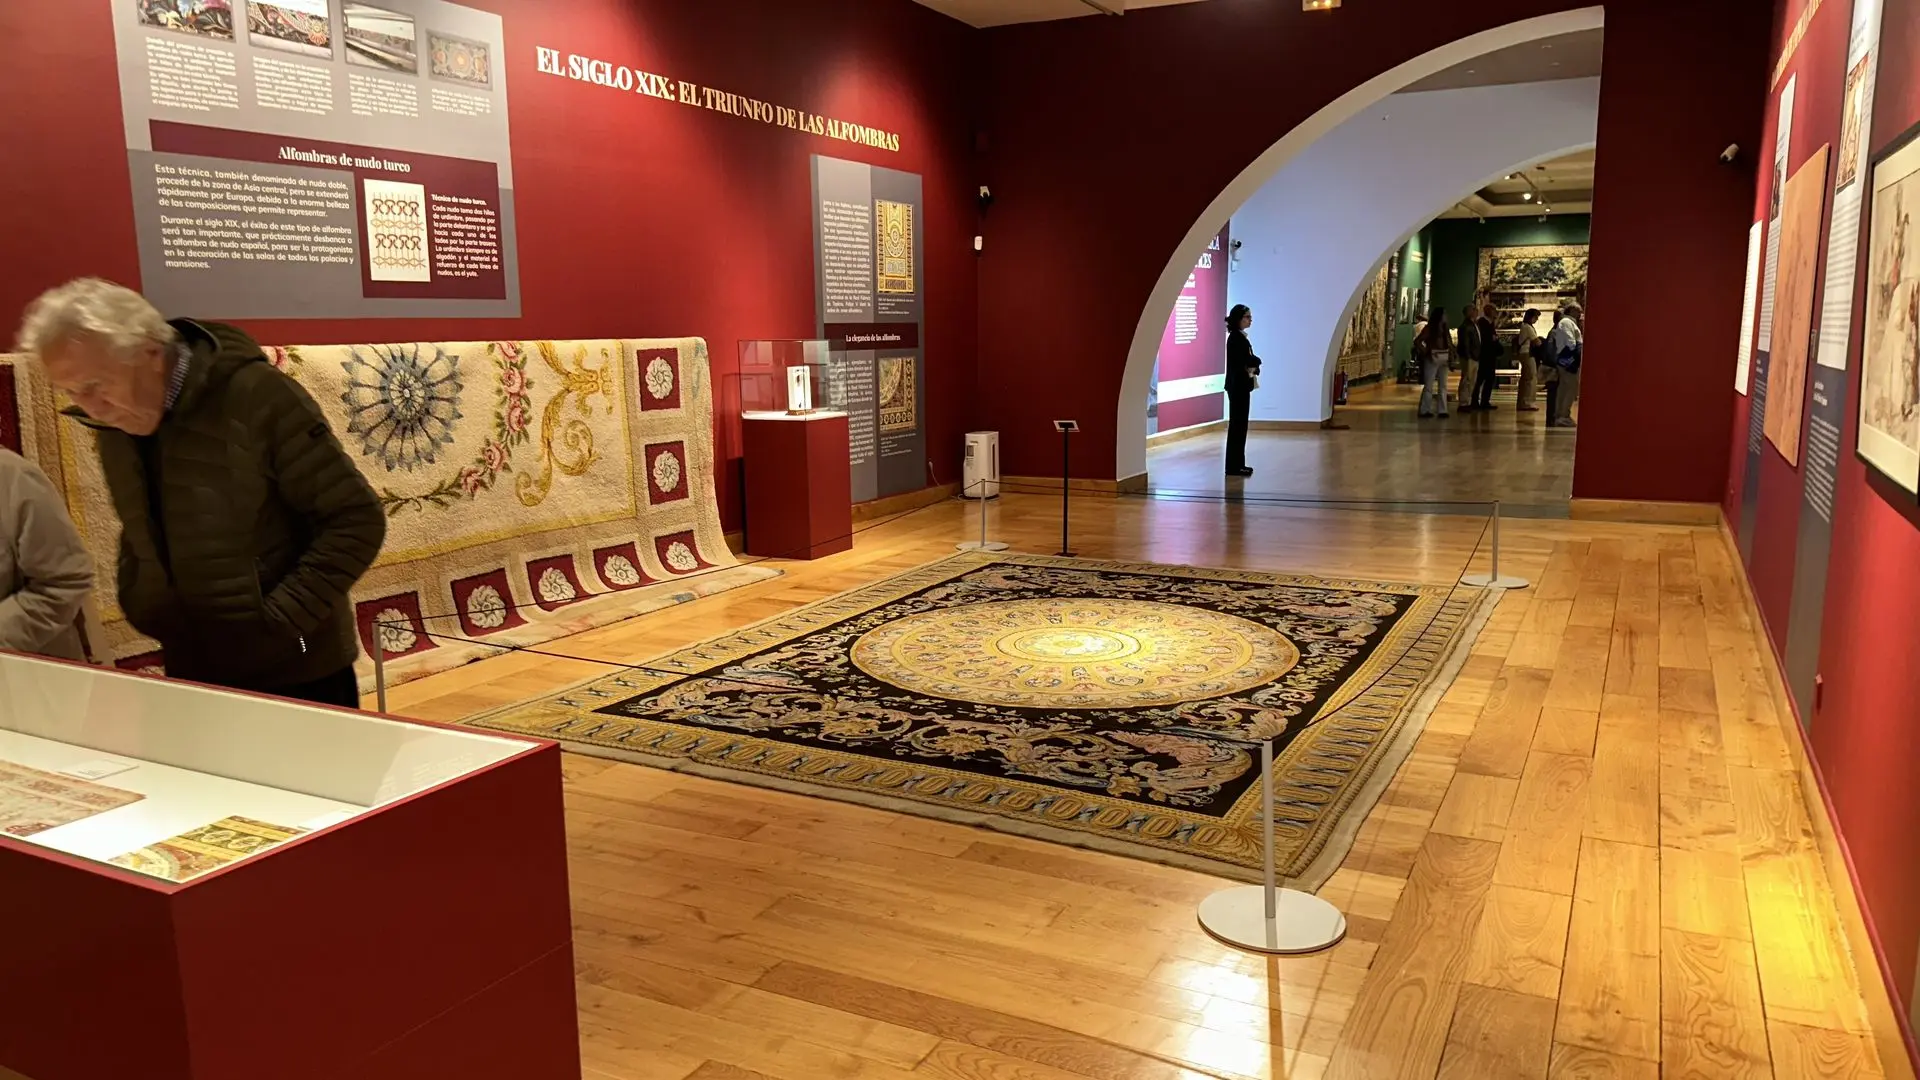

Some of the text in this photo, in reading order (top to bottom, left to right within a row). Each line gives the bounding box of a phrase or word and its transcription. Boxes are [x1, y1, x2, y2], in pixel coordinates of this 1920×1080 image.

[536, 46, 900, 152] EL SIGLO XIX: EL TRIUNFO DE LAS ALFOMBRAS
[278, 146, 410, 172] Alfombras de nudo turco
[155, 166, 176, 174] Esta
[178, 168, 212, 178] técnica,
[215, 172, 249, 180] también
[328, 182, 348, 190] doble,
[157, 178, 189, 186] procede
[244, 184, 260, 192] Asia
[158, 188, 209, 198] rápidamente
[226, 193, 254, 202] Europa,
[257, 196, 282, 204] debido
[185, 202, 241, 211] composiciones
[161, 216, 194, 225] Durante
[205, 219, 223, 228] siglo
[225, 220, 240, 228] XIX,
[173, 239, 207, 247] alfombra
[199, 230, 243, 239] importante,
[262, 233, 311, 242] prácticamente
